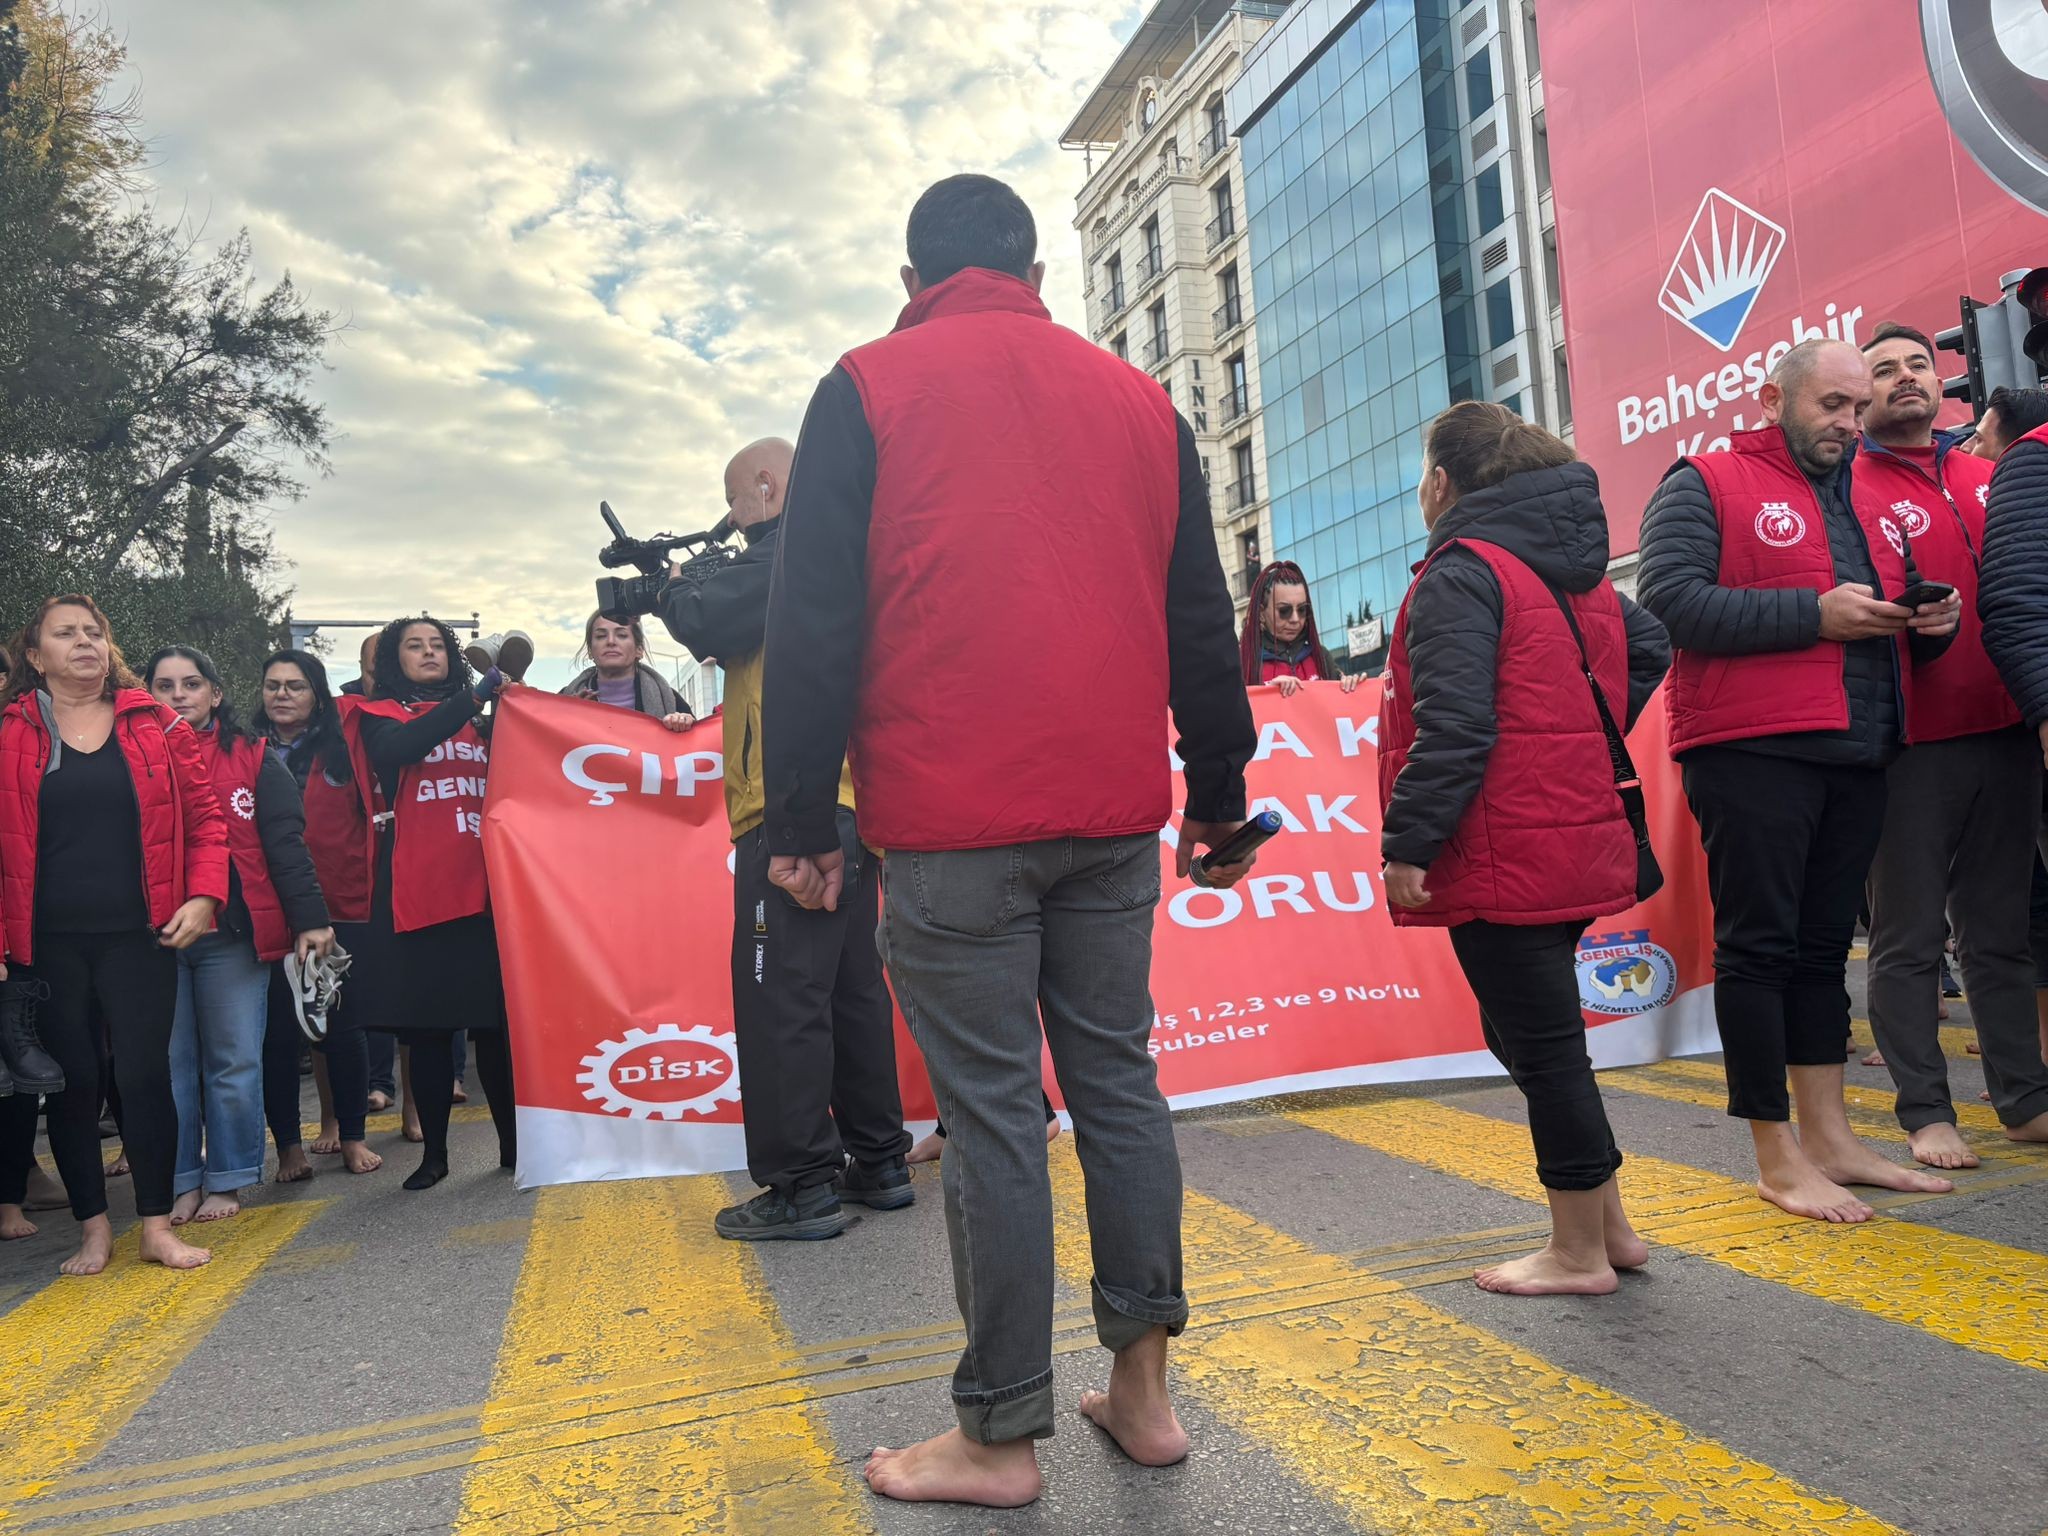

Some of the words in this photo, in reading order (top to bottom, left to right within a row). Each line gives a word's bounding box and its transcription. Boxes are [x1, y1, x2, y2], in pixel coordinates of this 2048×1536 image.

[1191, 359, 1208, 433] INN
[561, 743, 724, 806] ÇIP
[1335, 715, 1379, 757] K
[1166, 871, 1381, 929] ORU
[755, 943, 764, 974] TERREX
[1580, 943, 1653, 962] GENEL-İŞ
[1187, 996, 1266, 1022] 1,2,3
[1273, 992, 1312, 1009] ve
[1317, 987, 1338, 1004] 9
[1147, 1021, 1270, 1058] Şubeler
[616, 1055, 725, 1084] DİSK
